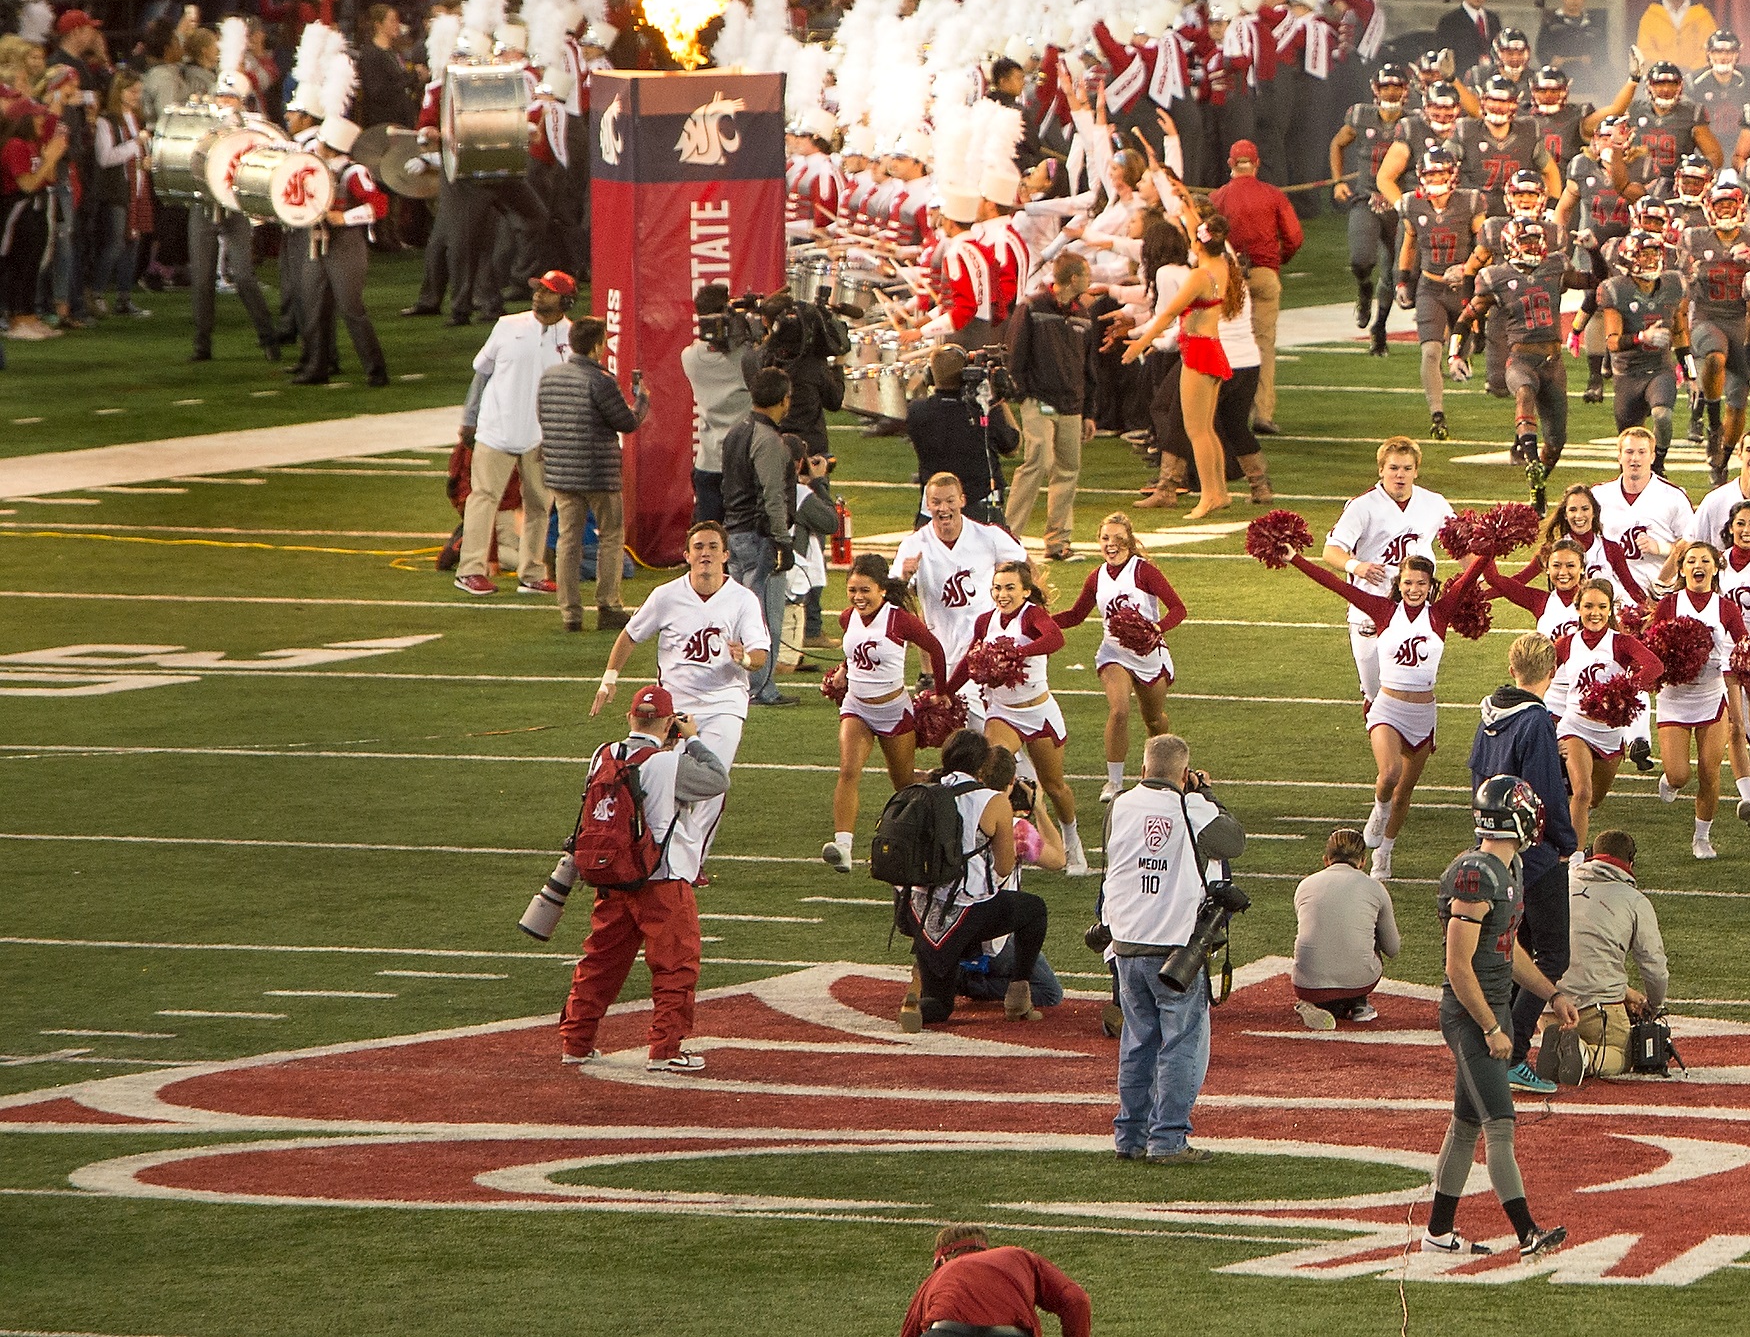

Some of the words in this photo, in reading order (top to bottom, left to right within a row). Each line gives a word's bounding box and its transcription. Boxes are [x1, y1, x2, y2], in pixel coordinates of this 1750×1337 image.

[1430, 232, 1457, 263] 17
[1520, 291, 1553, 329] 16
[1149, 835, 1162, 848] 12
[1138, 857, 1168, 872] MEDIA
[1141, 875, 1160, 895] 110
[1454, 869, 1481, 894] 46
